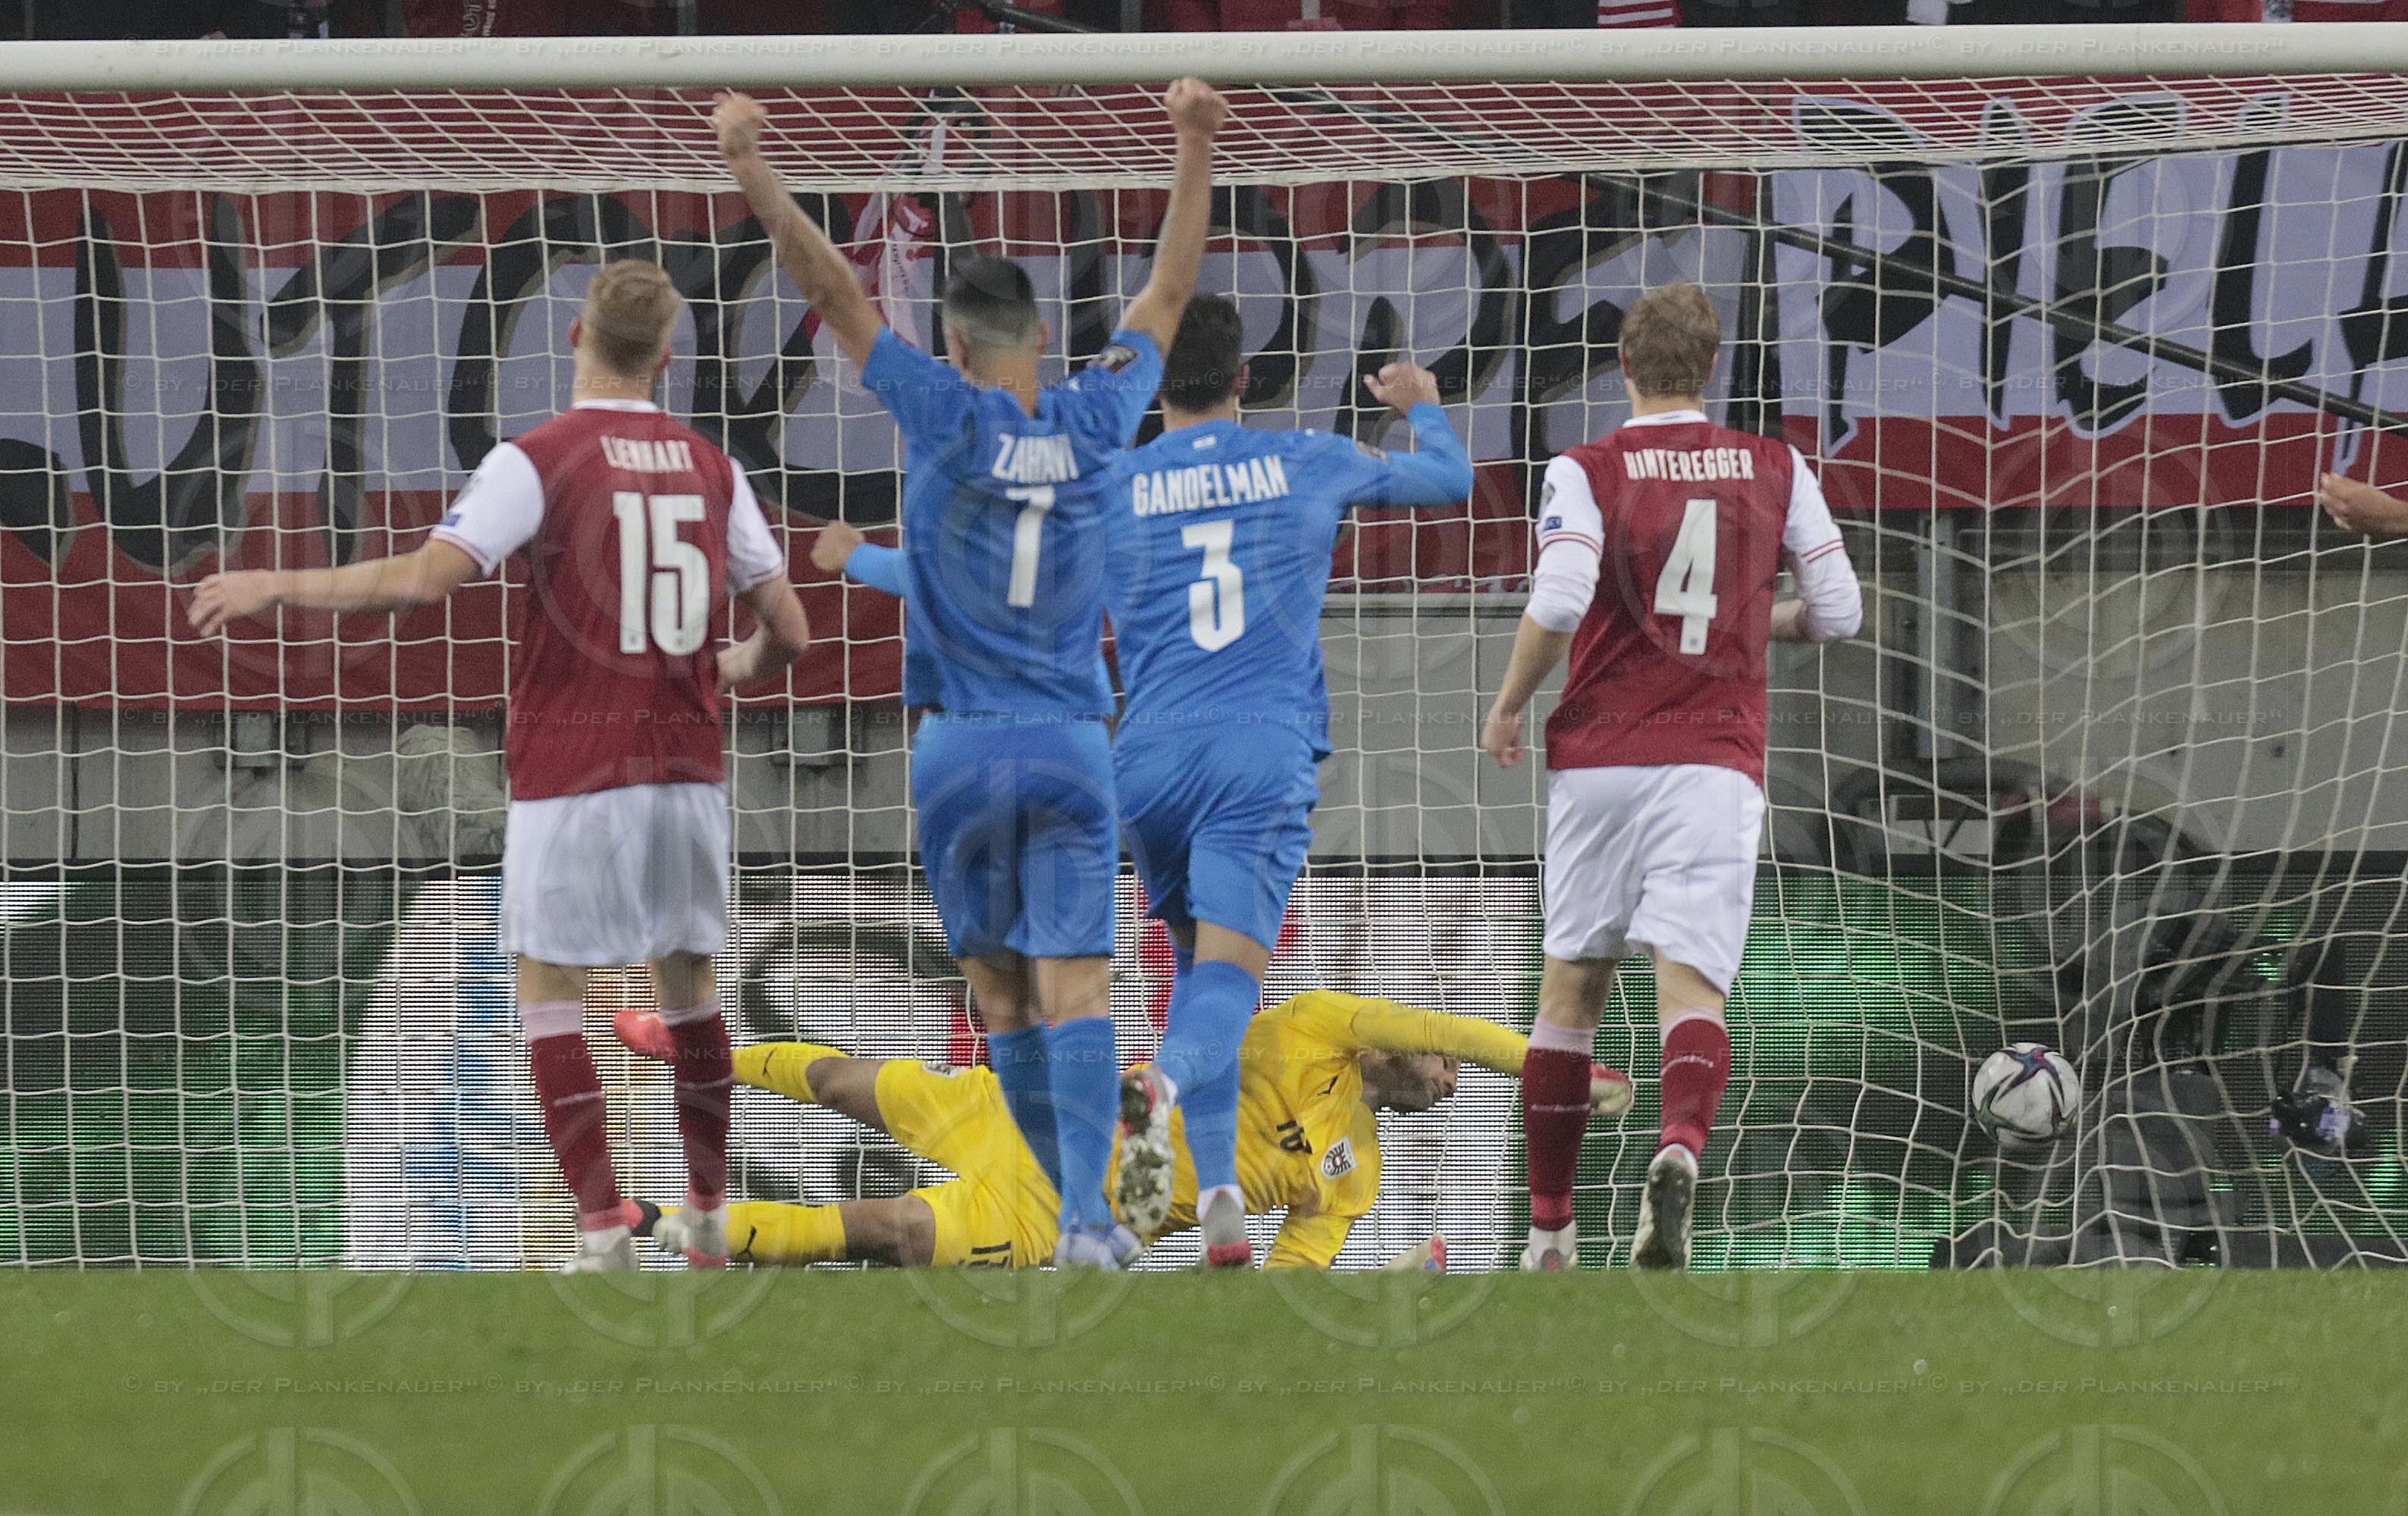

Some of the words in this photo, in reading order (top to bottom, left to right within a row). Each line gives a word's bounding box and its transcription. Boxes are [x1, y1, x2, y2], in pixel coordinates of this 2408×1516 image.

[1132, 456, 1290, 517] GANDELMAN
[1623, 447, 1754, 481] HINTEREGGER
[613, 491, 710, 656] 15
[1005, 484, 1055, 608] 7
[1180, 520, 1246, 653] 3
[1653, 499, 1717, 655] 4
